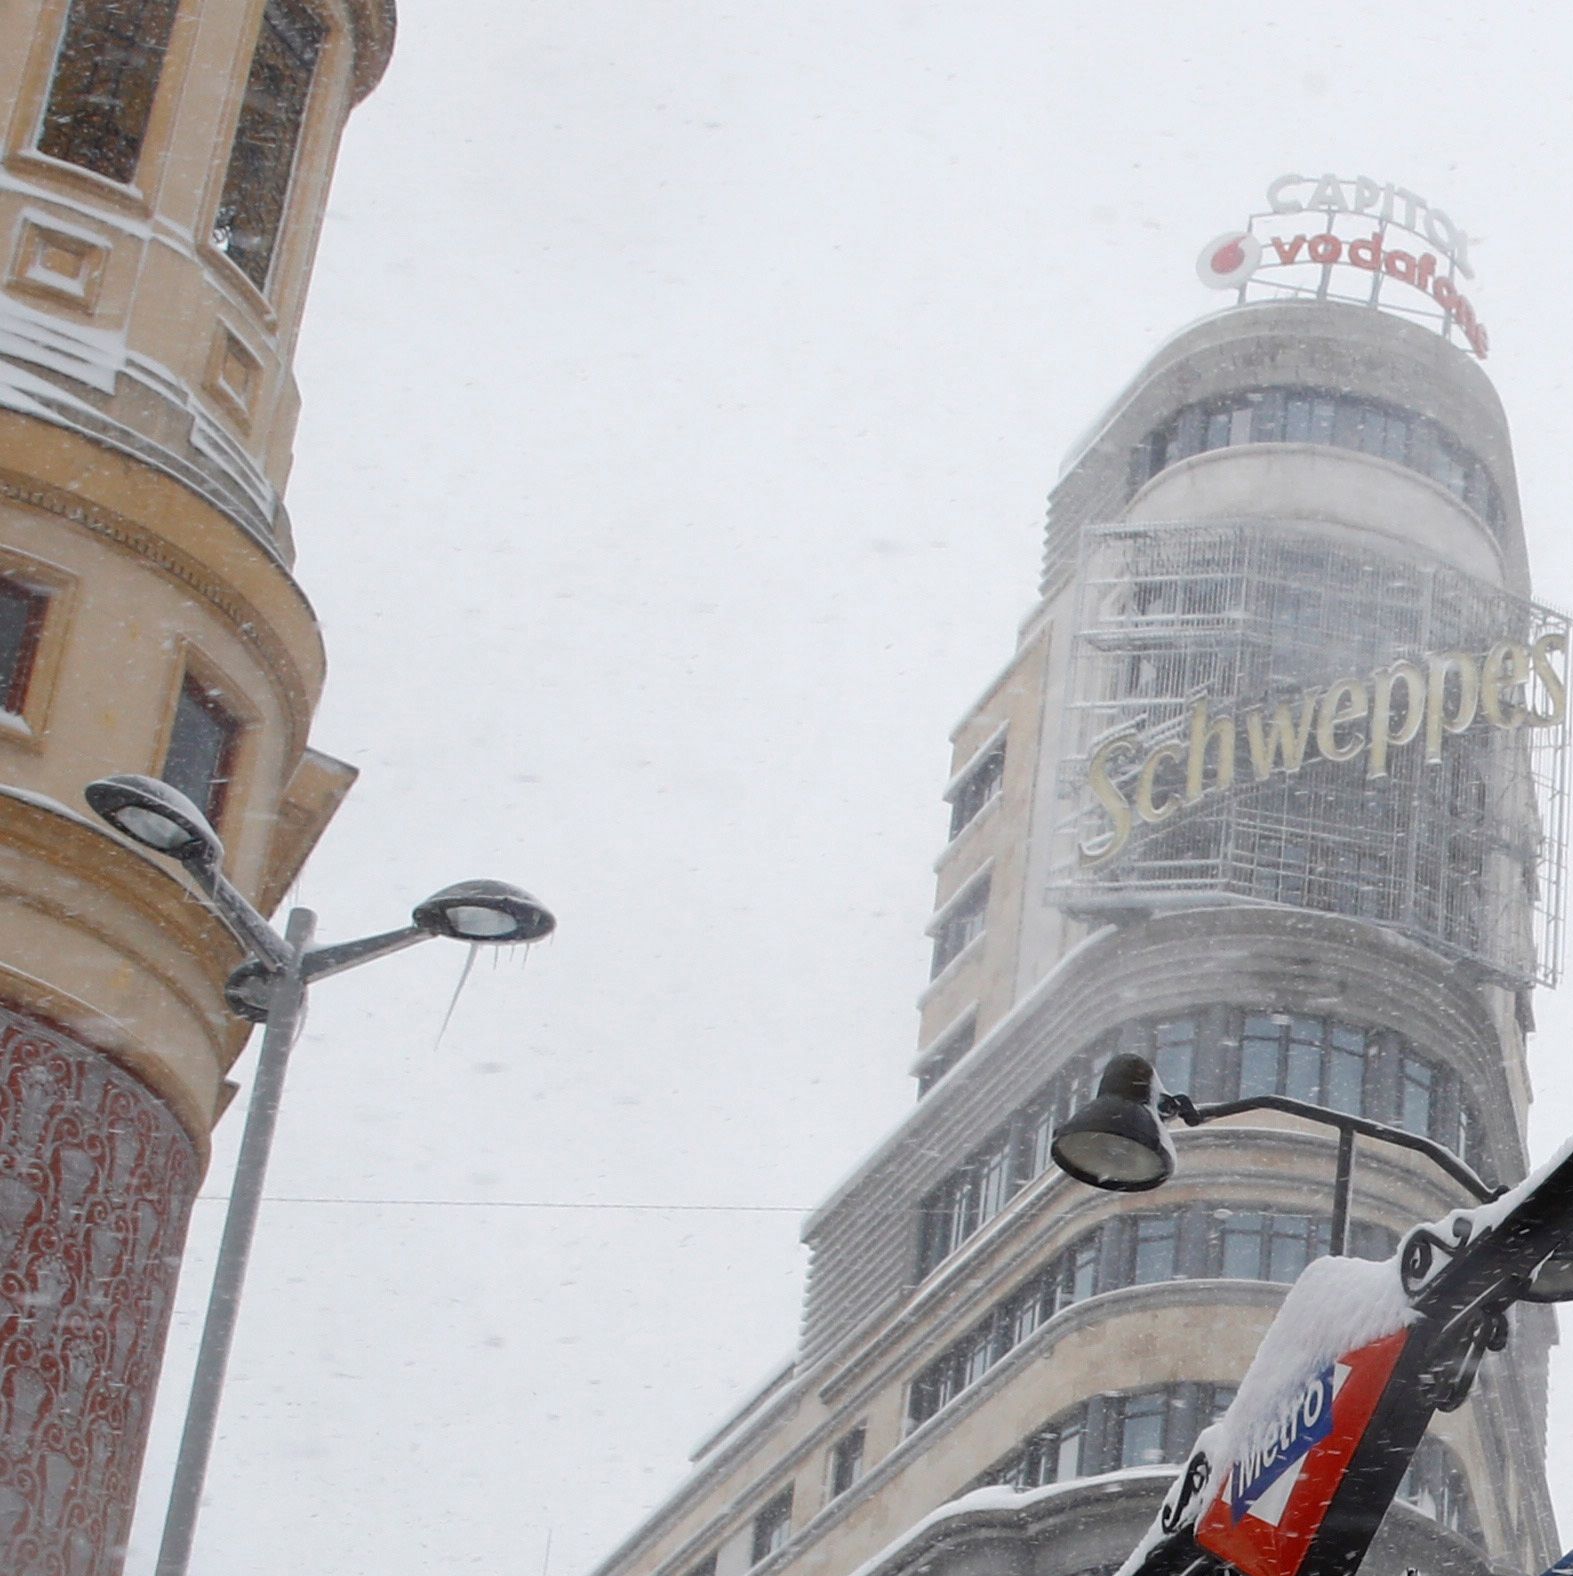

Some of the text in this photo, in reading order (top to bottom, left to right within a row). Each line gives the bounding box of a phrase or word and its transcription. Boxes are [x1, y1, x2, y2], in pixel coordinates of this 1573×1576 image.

[1266, 173, 1475, 280] CAPITOL
[1272, 231, 1489, 359] vodafone
[1078, 631, 1570, 868] Schweppes
[1238, 1378, 1324, 1499] Metro
